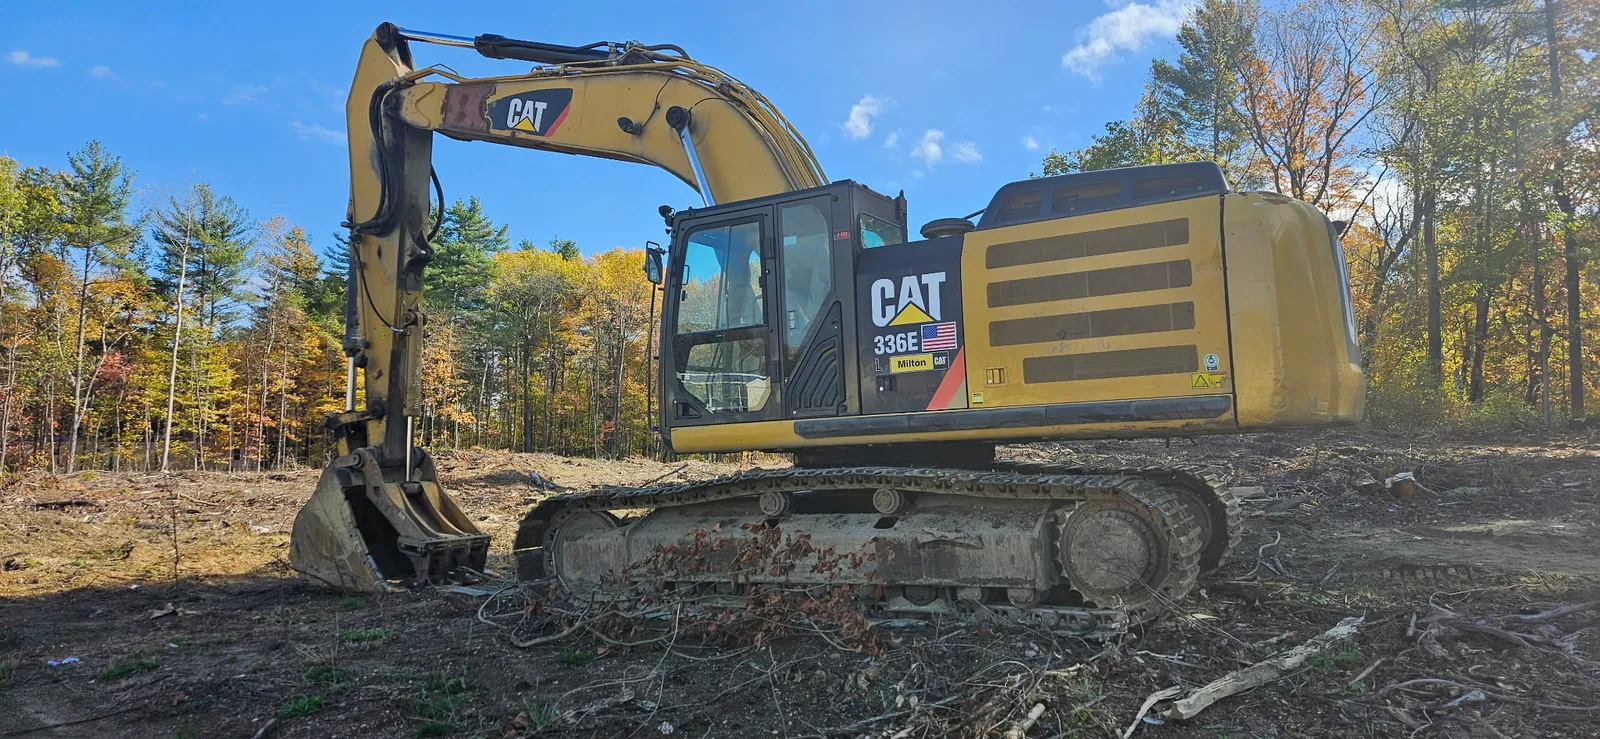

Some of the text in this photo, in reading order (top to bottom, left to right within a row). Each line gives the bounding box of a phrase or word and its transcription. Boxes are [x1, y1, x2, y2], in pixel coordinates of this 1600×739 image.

[507, 98, 547, 132] CAT
[871, 271, 946, 327] CAT
[874, 331, 918, 355] 336E
[897, 358, 926, 368] Milton
[934, 356, 946, 365] CAT
